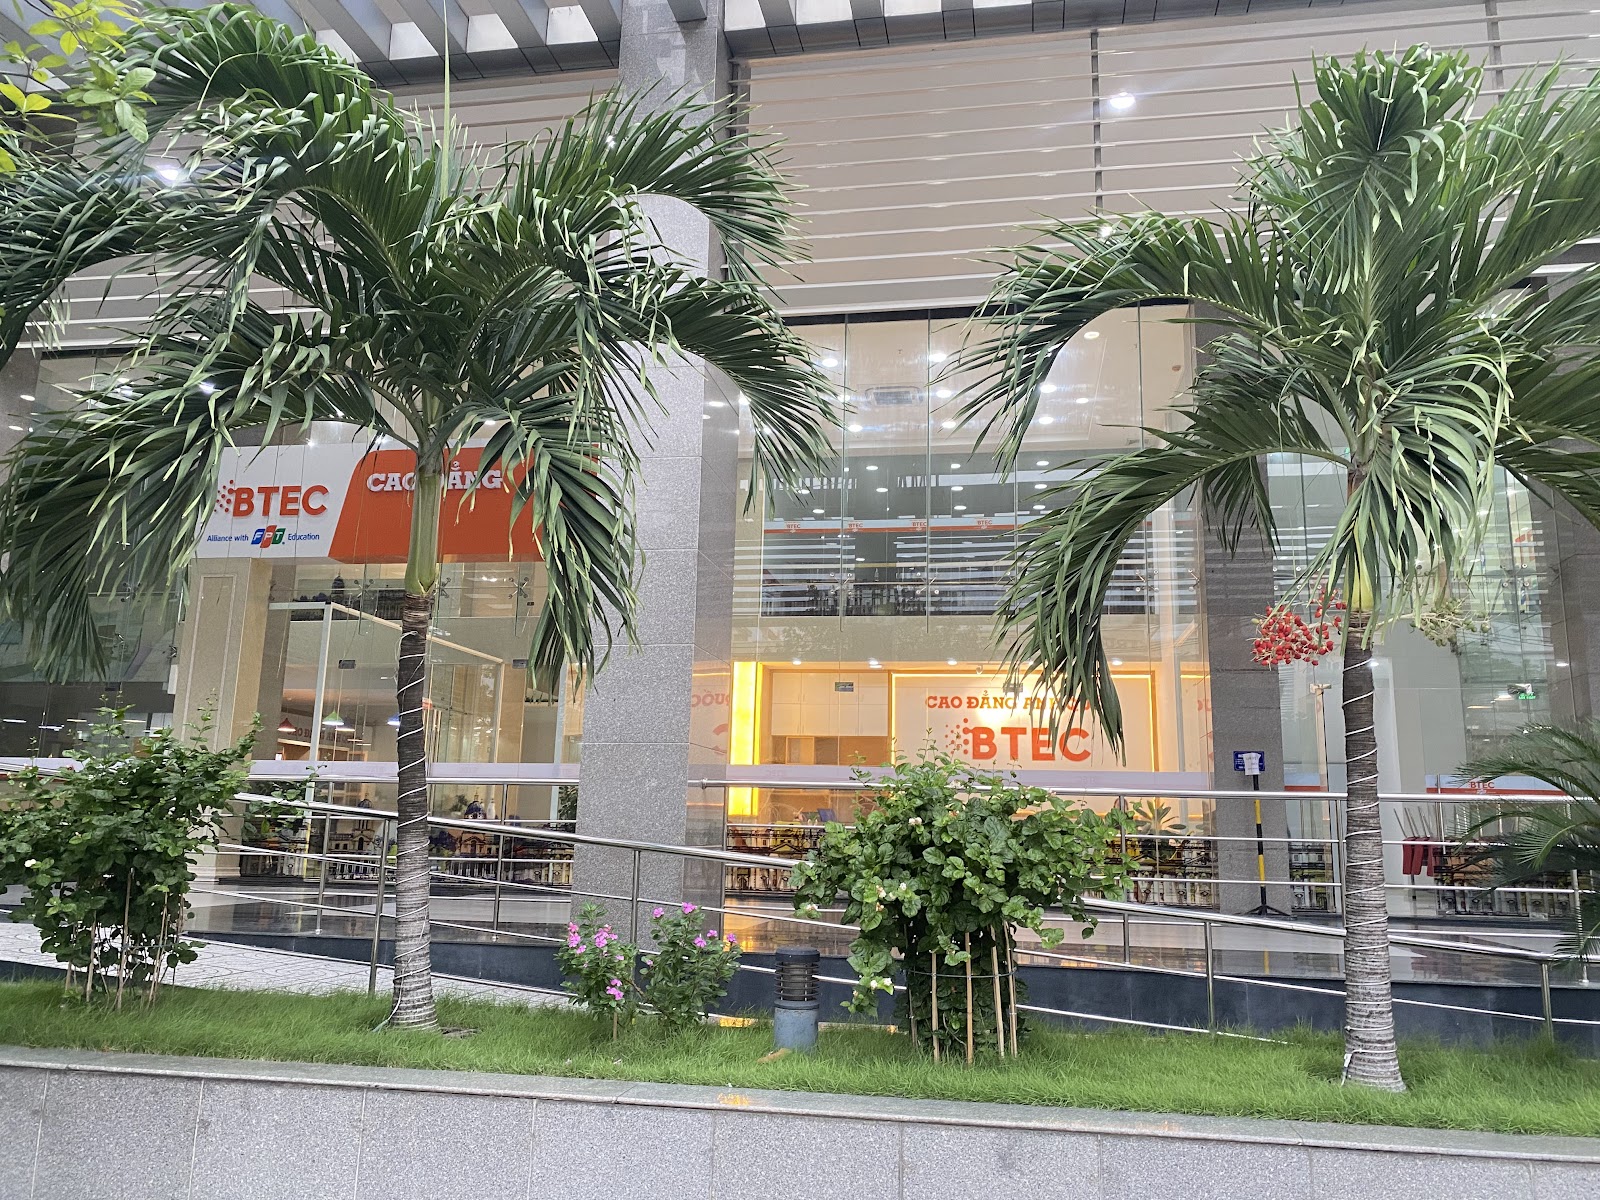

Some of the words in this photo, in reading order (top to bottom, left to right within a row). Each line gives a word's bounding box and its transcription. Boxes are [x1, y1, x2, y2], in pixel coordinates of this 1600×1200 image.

[440, 461, 503, 490] ẲNG
[231, 485, 329, 517] BTEC
[251, 525, 286, 548] FPT
[288, 533, 320, 541] Education
[927, 696, 963, 709] CAO
[963, 727, 1092, 762] BTEC
[1469, 781, 1495, 789] BTEC
